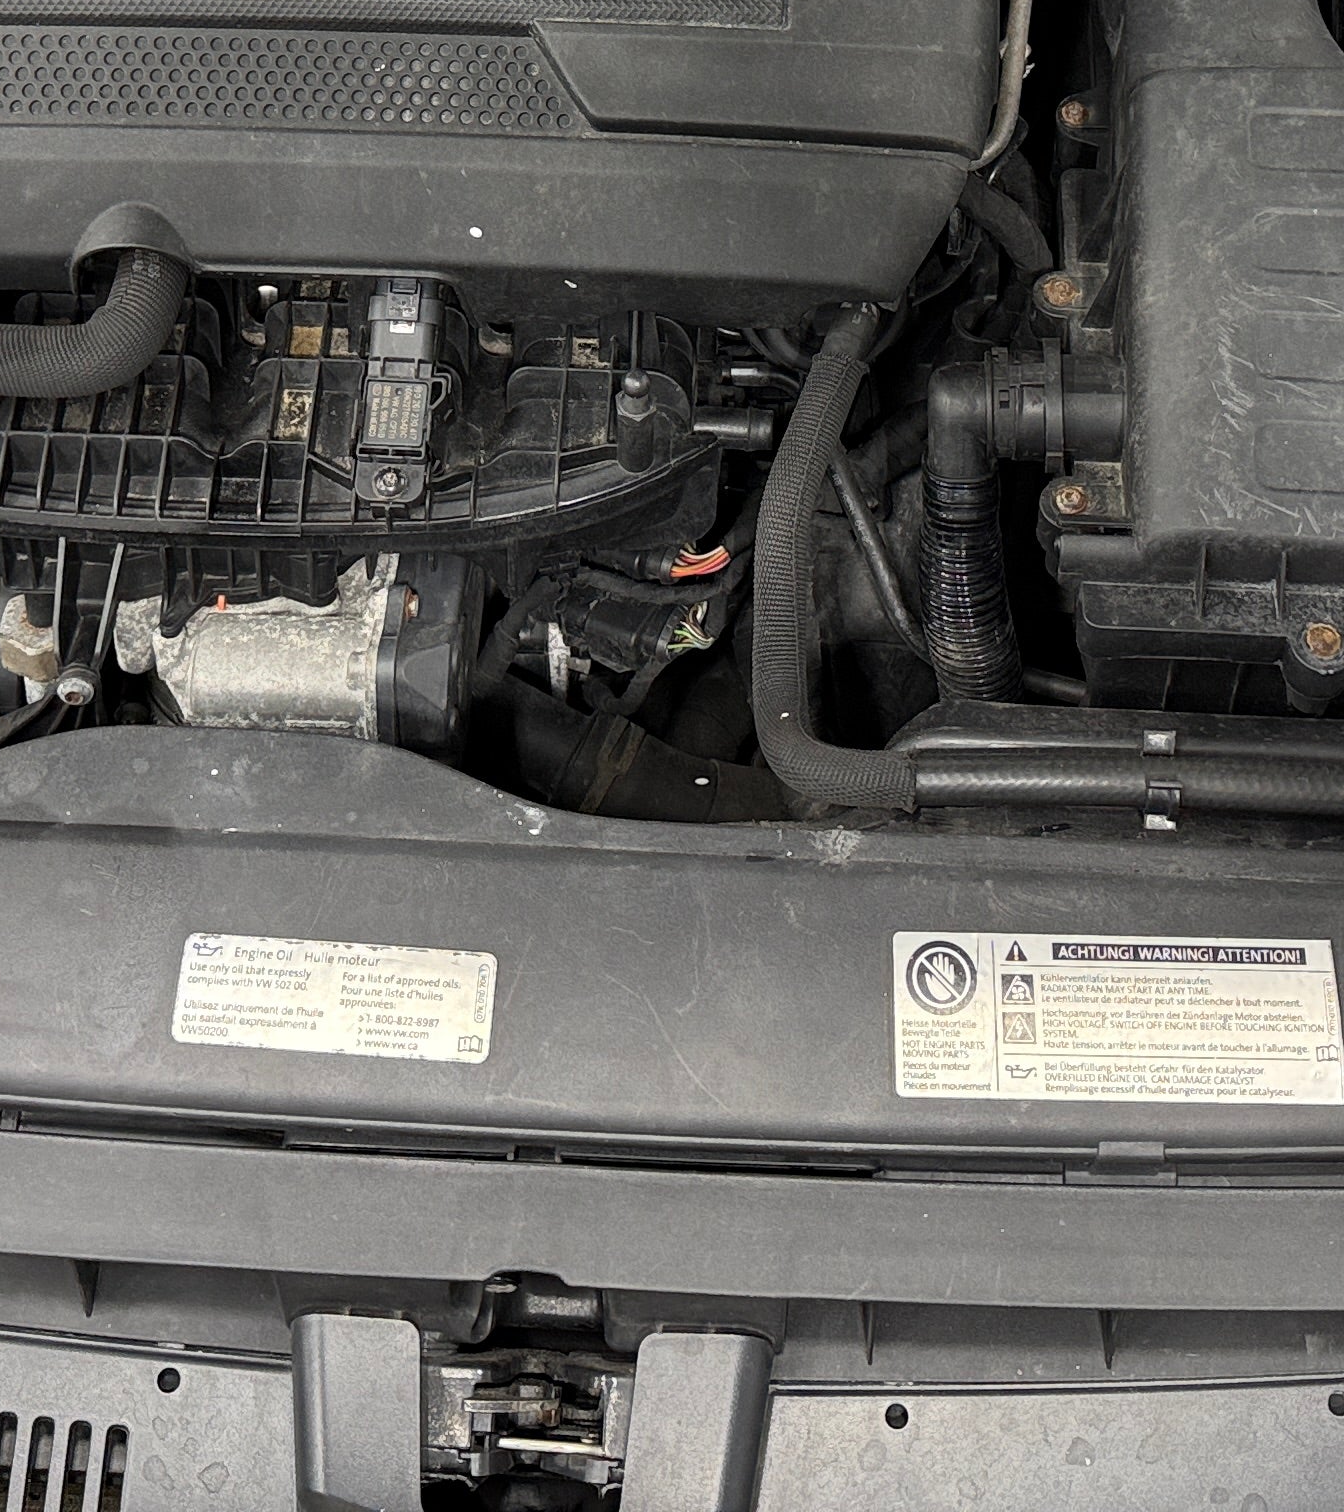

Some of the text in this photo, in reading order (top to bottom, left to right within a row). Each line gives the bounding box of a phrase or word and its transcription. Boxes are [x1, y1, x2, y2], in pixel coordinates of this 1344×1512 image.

[234, 946, 273, 962] Engine
[277, 949, 292, 960] Oil
[337, 954, 379, 967] moteur
[1058, 945, 1300, 962] ACHTUNG! WARNING! ATTENTION!
[189, 962, 206, 971] Use
[245, 965, 265, 974] that
[267, 966, 311, 980] expressly
[232, 978, 253, 987] with
[256, 980, 271, 988] VW
[342, 972, 357, 980] For
[384, 974, 393, 983] of
[396, 976, 440, 989] approved
[341, 985, 361, 995] Pour
[364, 988, 382, 996] une
[1041, 984, 1083, 992] RADIATOR
[1105, 985, 1124, 993] MAY
[1127, 985, 1151, 993] START
[1167, 986, 1184, 994] ANY
[1155, 997, 1173, 1006] peut
[1042, 1019, 1065, 1027] HIGH
[1110, 1020, 1144, 1028] SWITCH
[1146, 1021, 1161, 1029] OFF
[1200, 1022, 1231, 1030] BEFORE
[1235, 1023, 1281, 1031] TOUCHING
[902, 1039, 985, 1049] HOT ENGINE PARTS
[902, 1049, 968, 1058] MOVING PARTS
[1151, 1075, 1169, 1083] CAN
[1172, 1075, 1211, 1084] DAMAGE
[1216, 1088, 1236, 1096] pour
